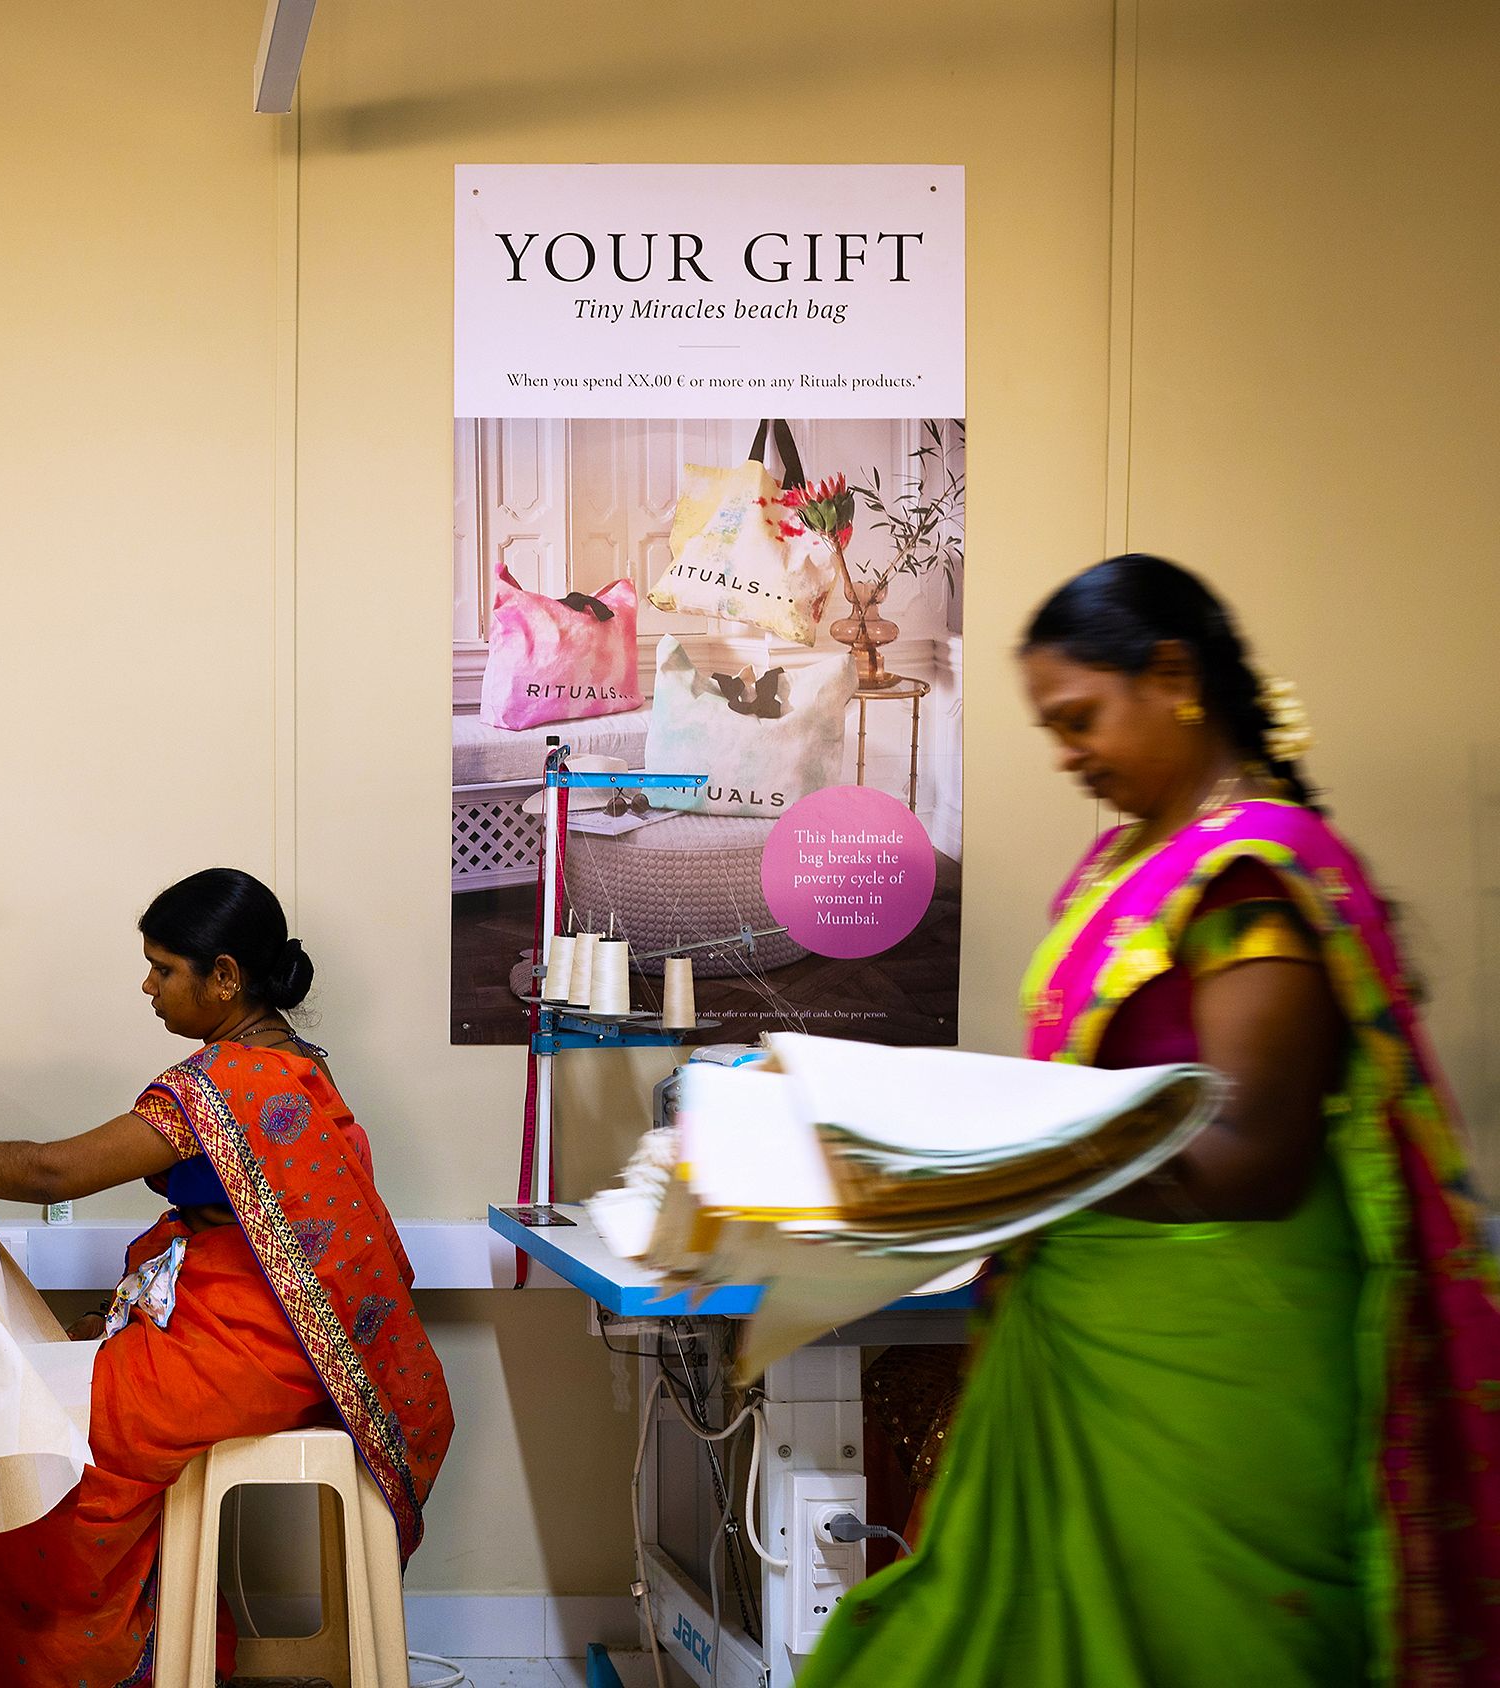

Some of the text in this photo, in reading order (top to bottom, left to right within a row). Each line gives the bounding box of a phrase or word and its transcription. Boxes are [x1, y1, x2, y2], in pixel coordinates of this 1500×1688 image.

[495, 231, 924, 283] YOUR GIFT
[574, 298, 849, 325] Tiny Miracles beach bag
[507, 373, 549, 388] When
[553, 377, 579, 391] you
[583, 373, 623, 391] spend
[627, 373, 672, 390] XX,00
[676, 374, 686, 388] €
[690, 377, 705, 388] or
[710, 378, 744, 388] more
[748, 378, 766, 388] on
[770, 378, 795, 392] any
[800, 373, 848, 388] Rituals
[794, 829, 904, 844] This handmade
[799, 849, 899, 868] bag breaks the
[794, 870, 906, 888] poverty cycle of
[813, 891, 883, 905] women in
[816, 910, 879, 925] Mumbai.
[702, 1009, 721, 1018] other
[722, 1009, 739, 1018] offer
[759, 1009, 789, 1020] purchase
[799, 1009, 812, 1020] gift
[833, 1009, 849, 1018] One
[850, 1011, 862, 1020] per
[863, 1011, 889, 1020] person.
